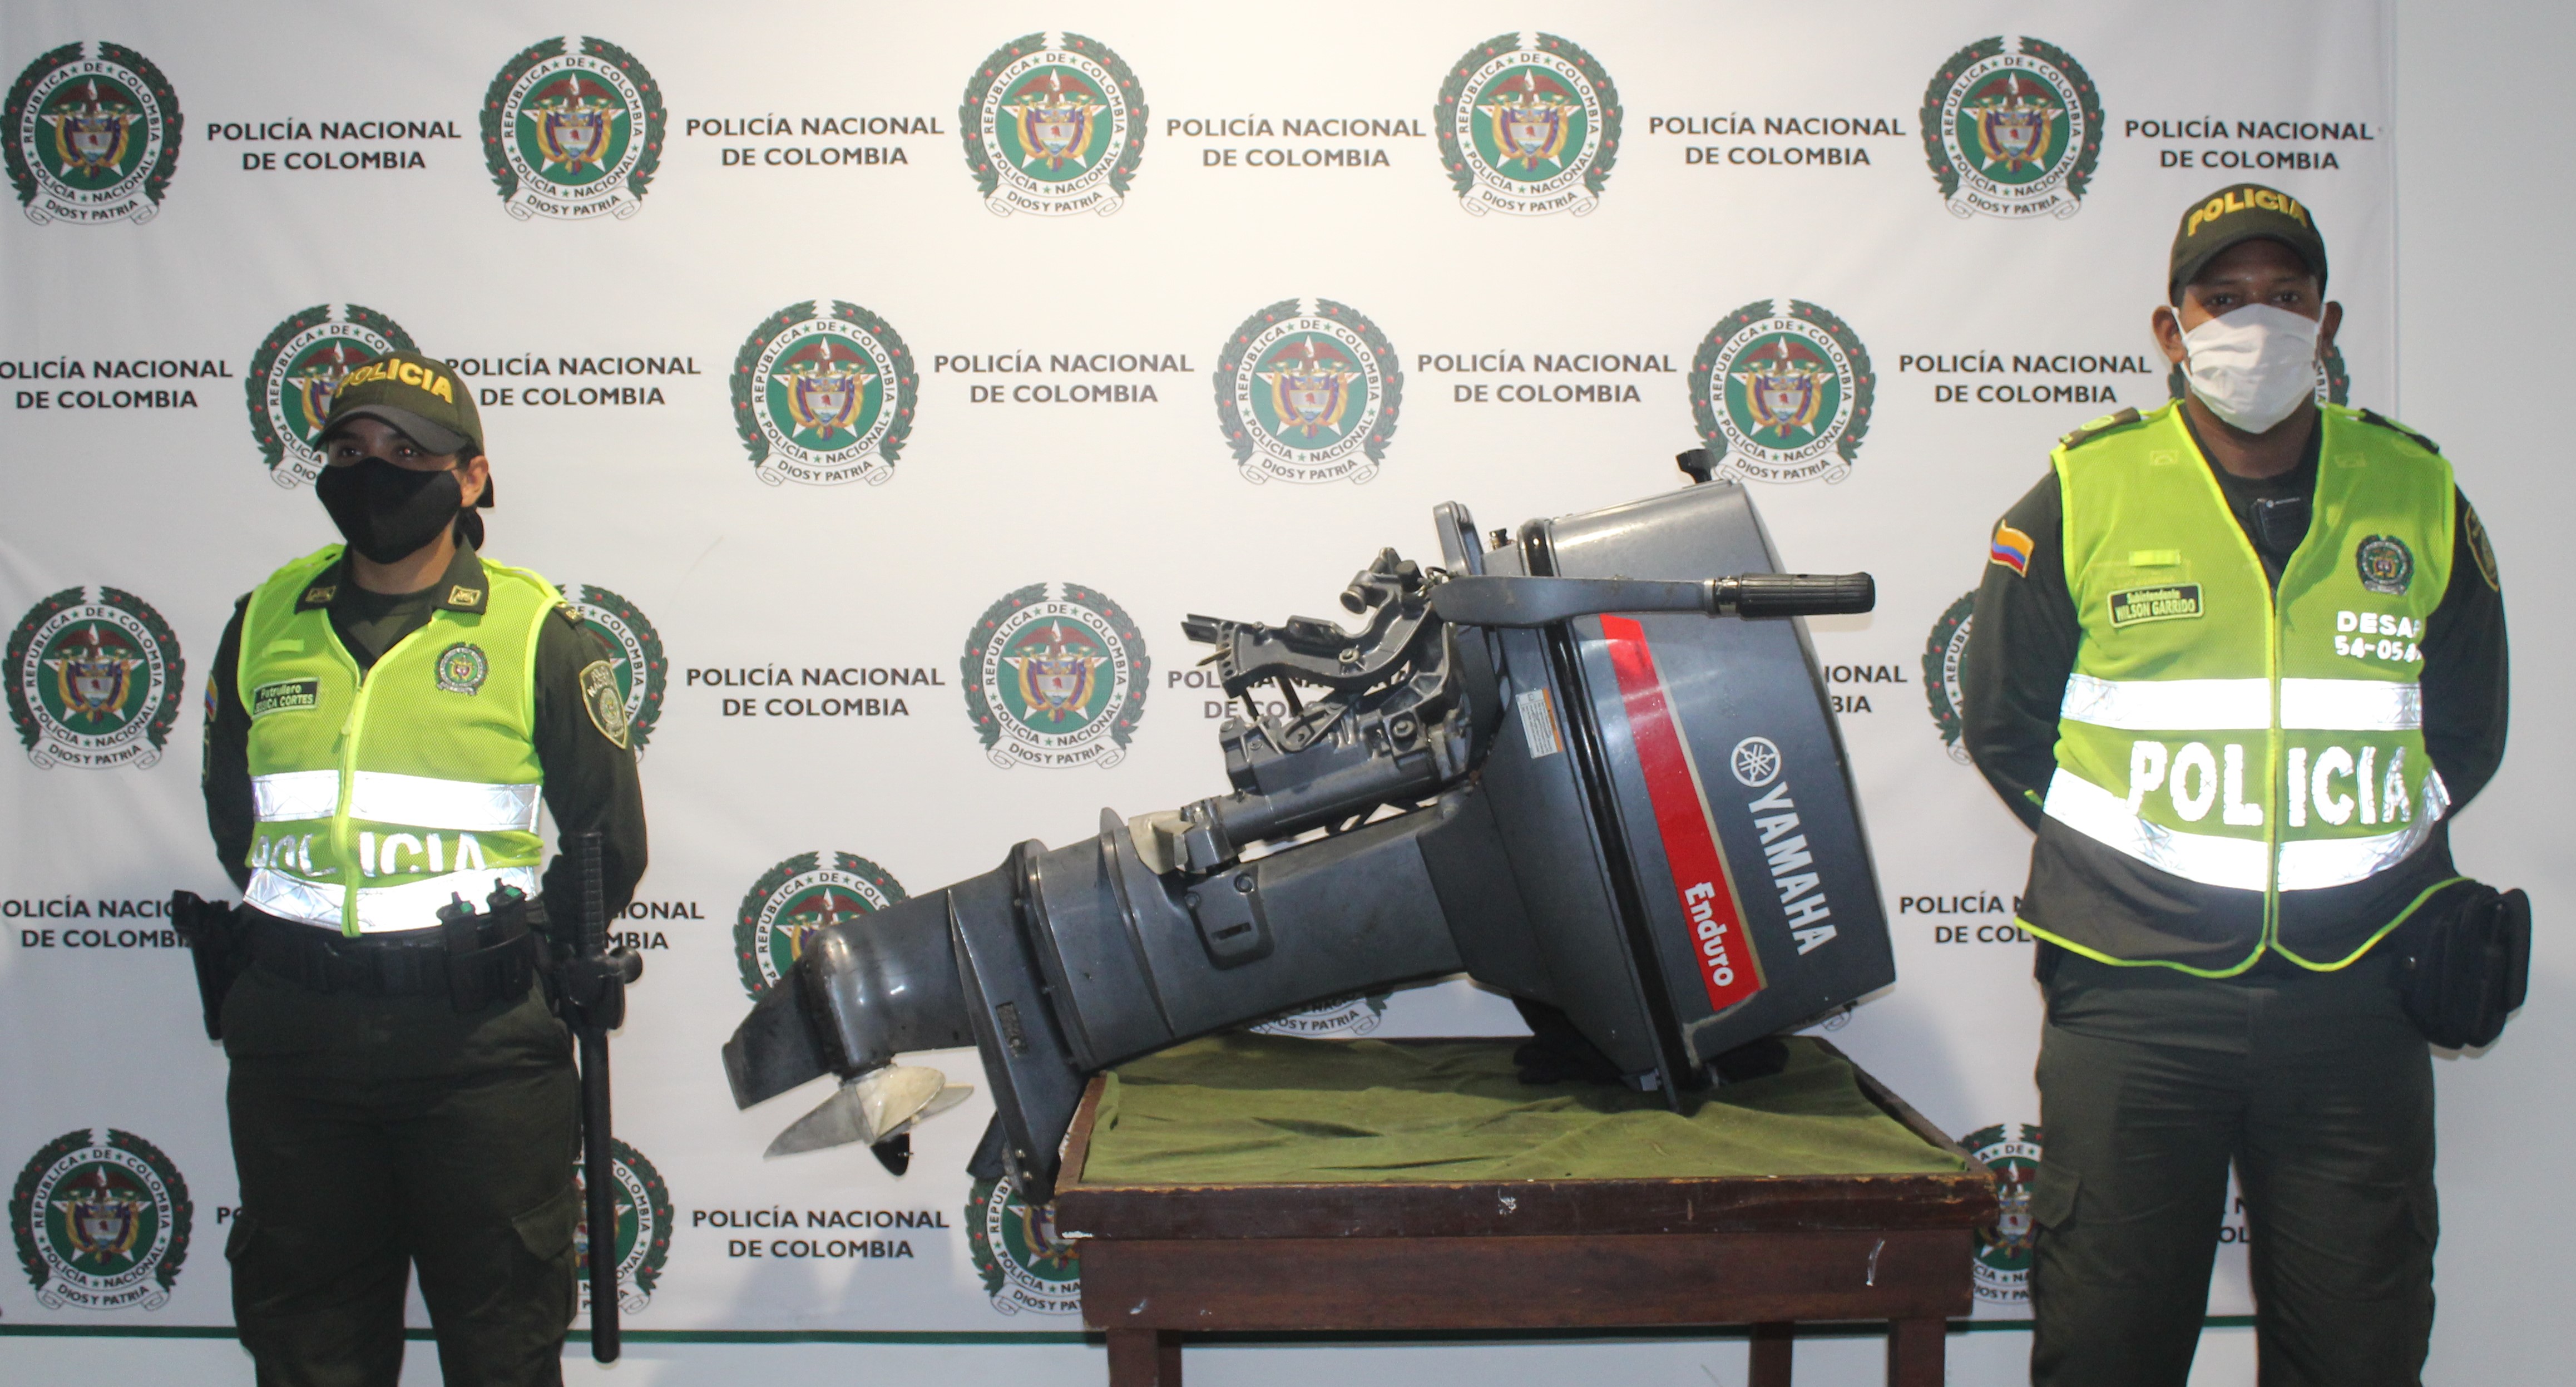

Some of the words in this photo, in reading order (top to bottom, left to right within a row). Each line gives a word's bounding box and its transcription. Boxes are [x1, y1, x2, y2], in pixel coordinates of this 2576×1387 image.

[84, 63, 102, 71] DE
[118, 71, 160, 141] COLOMBIA
[566, 57, 585, 66] DE
[600, 66, 643, 136] COLOMBIA
[1046, 53, 1065, 62] DE
[1081, 62, 1125, 133] COLOMBIA
[1521, 53, 1540, 62] DE
[1556, 62, 1599, 134] COLOMBIA
[2005, 57, 2023, 65] DE
[2039, 66, 2081, 136] COLOMBIA
[321, 121, 461, 140] NACIONAL
[802, 117, 944, 135] NACIONAL
[1283, 119, 1426, 137] NACIONAL
[1764, 117, 1906, 136] NACIONAL
[2237, 121, 2374, 140] NACIONAL
[243, 152, 275, 170] DE
[284, 151, 426, 170] COLOMBIA
[722, 148, 755, 166] DE
[764, 147, 908, 166] COLOMBIA
[1203, 149, 1237, 166] DE
[1245, 149, 1390, 167] COLOMBIA
[1686, 147, 1719, 164] DE
[1728, 147, 1871, 165] COLOMBIA
[2160, 150, 2193, 167] DE
[2202, 151, 2339, 170] COLOMBIA
[92, 159, 153, 201] NACIONAL
[574, 154, 636, 197] NACIONAL
[1055, 150, 1118, 194] NACIONAL
[1530, 150, 1593, 194] NACIONAL
[2014, 153, 2075, 196] NACIONAL
[573, 195, 620, 215] PATRIA
[1055, 191, 1102, 211] PATRIA
[1530, 191, 1577, 211] PATRIA
[2014, 194, 2060, 214] PATRIA
[2187, 187, 2307, 237] POLICIA
[331, 327, 350, 335] DE
[0, 356, 85, 379] OLICÍA
[93, 360, 233, 378] NACIONAL
[559, 357, 701, 375] NACIONAL
[817, 322, 835, 330] DE
[852, 330, 895, 402] COLOMBIA
[1051, 354, 1194, 372] NACIONAL
[1301, 320, 1319, 329] DE
[1336, 328, 1380, 401] COLOMBIA
[1534, 354, 1677, 372] NACIONAL
[1774, 320, 1793, 329] DE
[1809, 329, 1852, 401] COLOMBIA
[2013, 356, 2152, 373] NACIONAL
[335, 358, 453, 404] POLICIA
[16, 391, 50, 409] DE
[57, 391, 197, 409] COLOMBIA
[481, 388, 513, 406] DE
[522, 387, 665, 406] COLOMBIA
[971, 385, 1005, 403] DE
[1013, 384, 1158, 403] COLOMBIA
[1455, 384, 1488, 402] DE
[1497, 384, 1641, 402] COLOMBIA
[1935, 385, 1968, 402] DE
[1977, 385, 2117, 403] COLOMBIA
[826, 419, 888, 463] NACIONAL
[1310, 417, 1373, 461] NACIONAL
[1784, 418, 1846, 461] NACIONAL
[825, 461, 873, 481] PATRIA
[1310, 459, 1357, 479] PATRIA
[1783, 459, 1830, 479] PATRIA
[2115, 603, 2151, 622] WILSON
[2152, 598, 2197, 616] GARRIDO
[85, 608, 103, 616] DE
[120, 616, 161, 687] COLOMBIA
[601, 615, 644, 686] COLOMBIA
[1047, 604, 1066, 613] DE
[1083, 613, 1126, 685] COLOMBIA
[802, 668, 945, 686] NACIONAL
[1825, 665, 1908, 683] IONAL
[279, 693, 314, 707] CORTES
[723, 699, 757, 716] DE
[765, 698, 909, 717] COLOMBIA
[1204, 701, 1238, 719] DE
[95, 703, 156, 747] NACIONAL
[1057, 702, 1120, 746] NACIONAL
[1057, 743, 1104, 764] PATRIA
[2125, 740, 2412, 827] POLICIA
[820, 873, 839, 881] DE
[1748, 781, 1838, 956] YAMAHA
[0, 895, 91, 918] OLICÍA
[1900, 890, 2005, 914] POLICÍA
[22, 930, 55, 947] DE
[63, 929, 187, 948] COLOMBI
[1684, 881, 1735, 987] Enduro
[1936, 926, 1967, 944] DE
[93, 1150, 111, 1158] DE
[127, 1158, 170, 1228] COLOMBIA
[807, 1211, 950, 1228] NACIONAL
[729, 1240, 762, 1258] DE
[770, 1240, 914, 1258] COLOMBIA
[103, 1245, 164, 1287] NACIONAL
